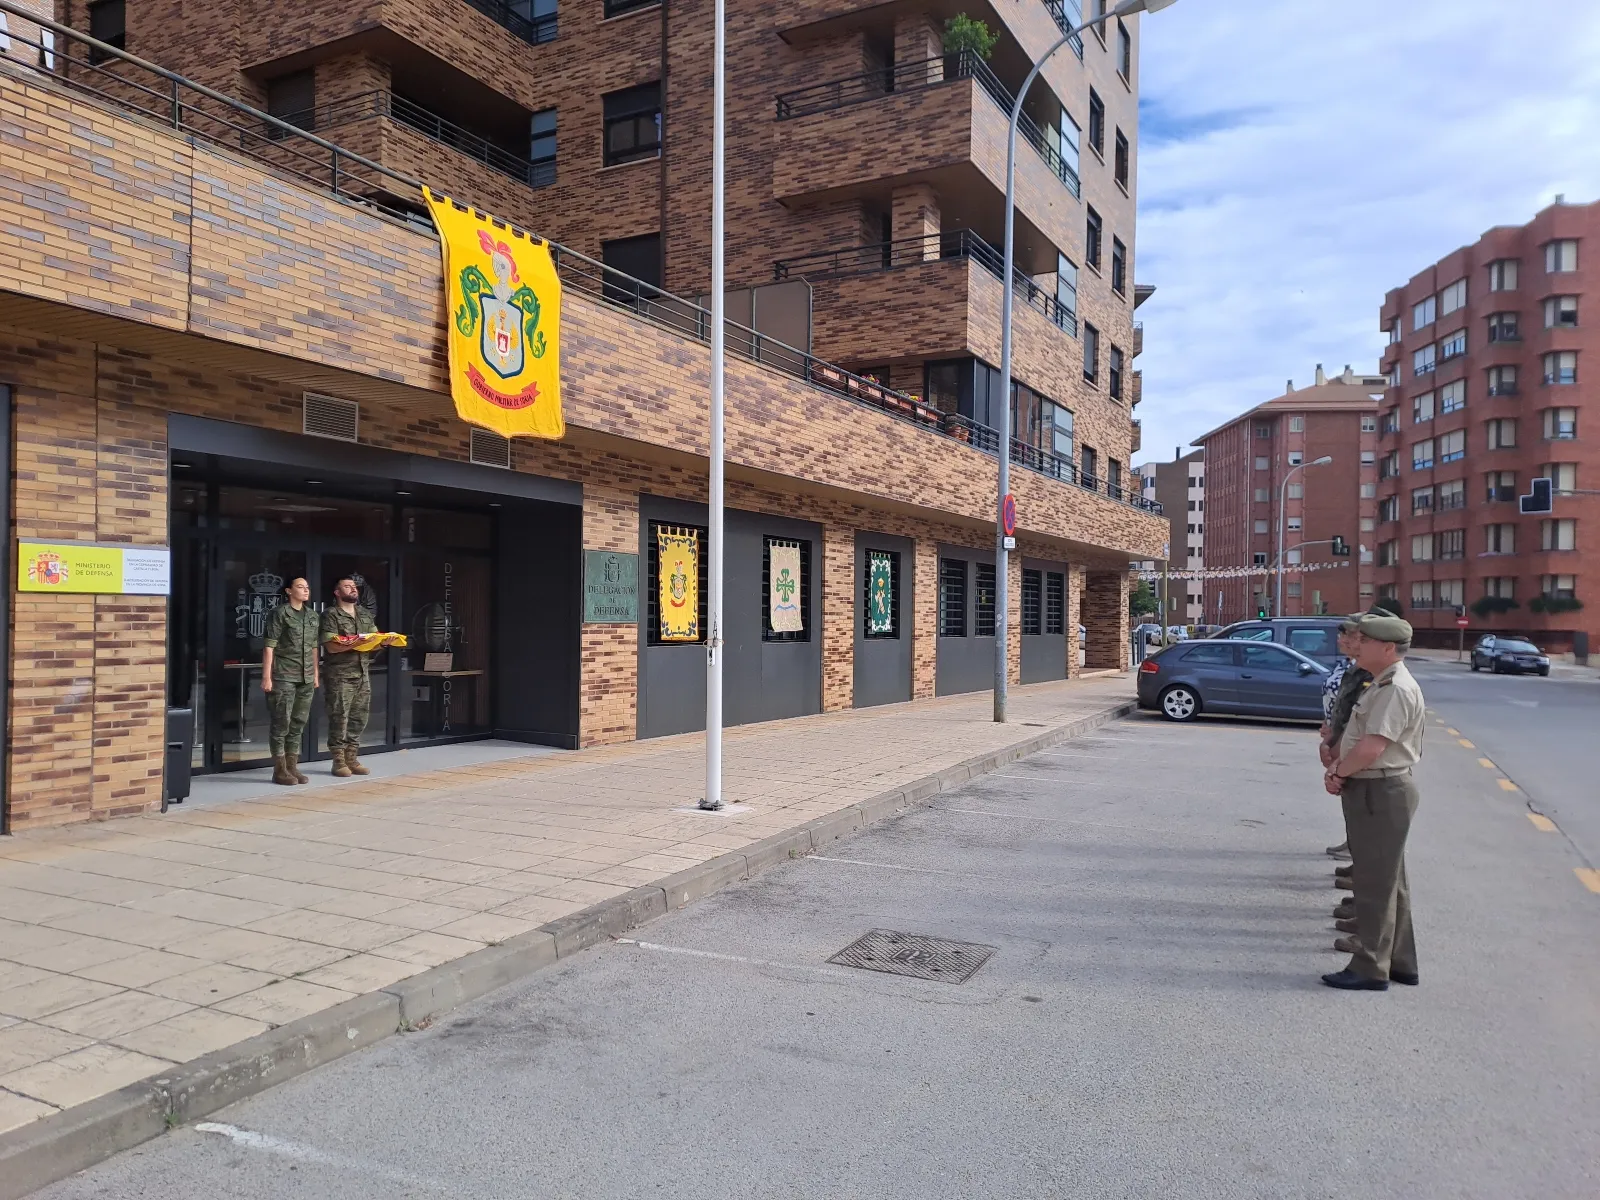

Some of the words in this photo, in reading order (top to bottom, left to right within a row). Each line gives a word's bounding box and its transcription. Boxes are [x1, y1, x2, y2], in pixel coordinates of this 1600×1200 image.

[473, 378, 495, 401] GOBIERNO
[494, 394, 513, 407] MILITAR
[85, 569, 114, 577] DEFENSA
[443, 562, 453, 653] DEFENSA
[593, 606, 630, 616] DEFENSA
